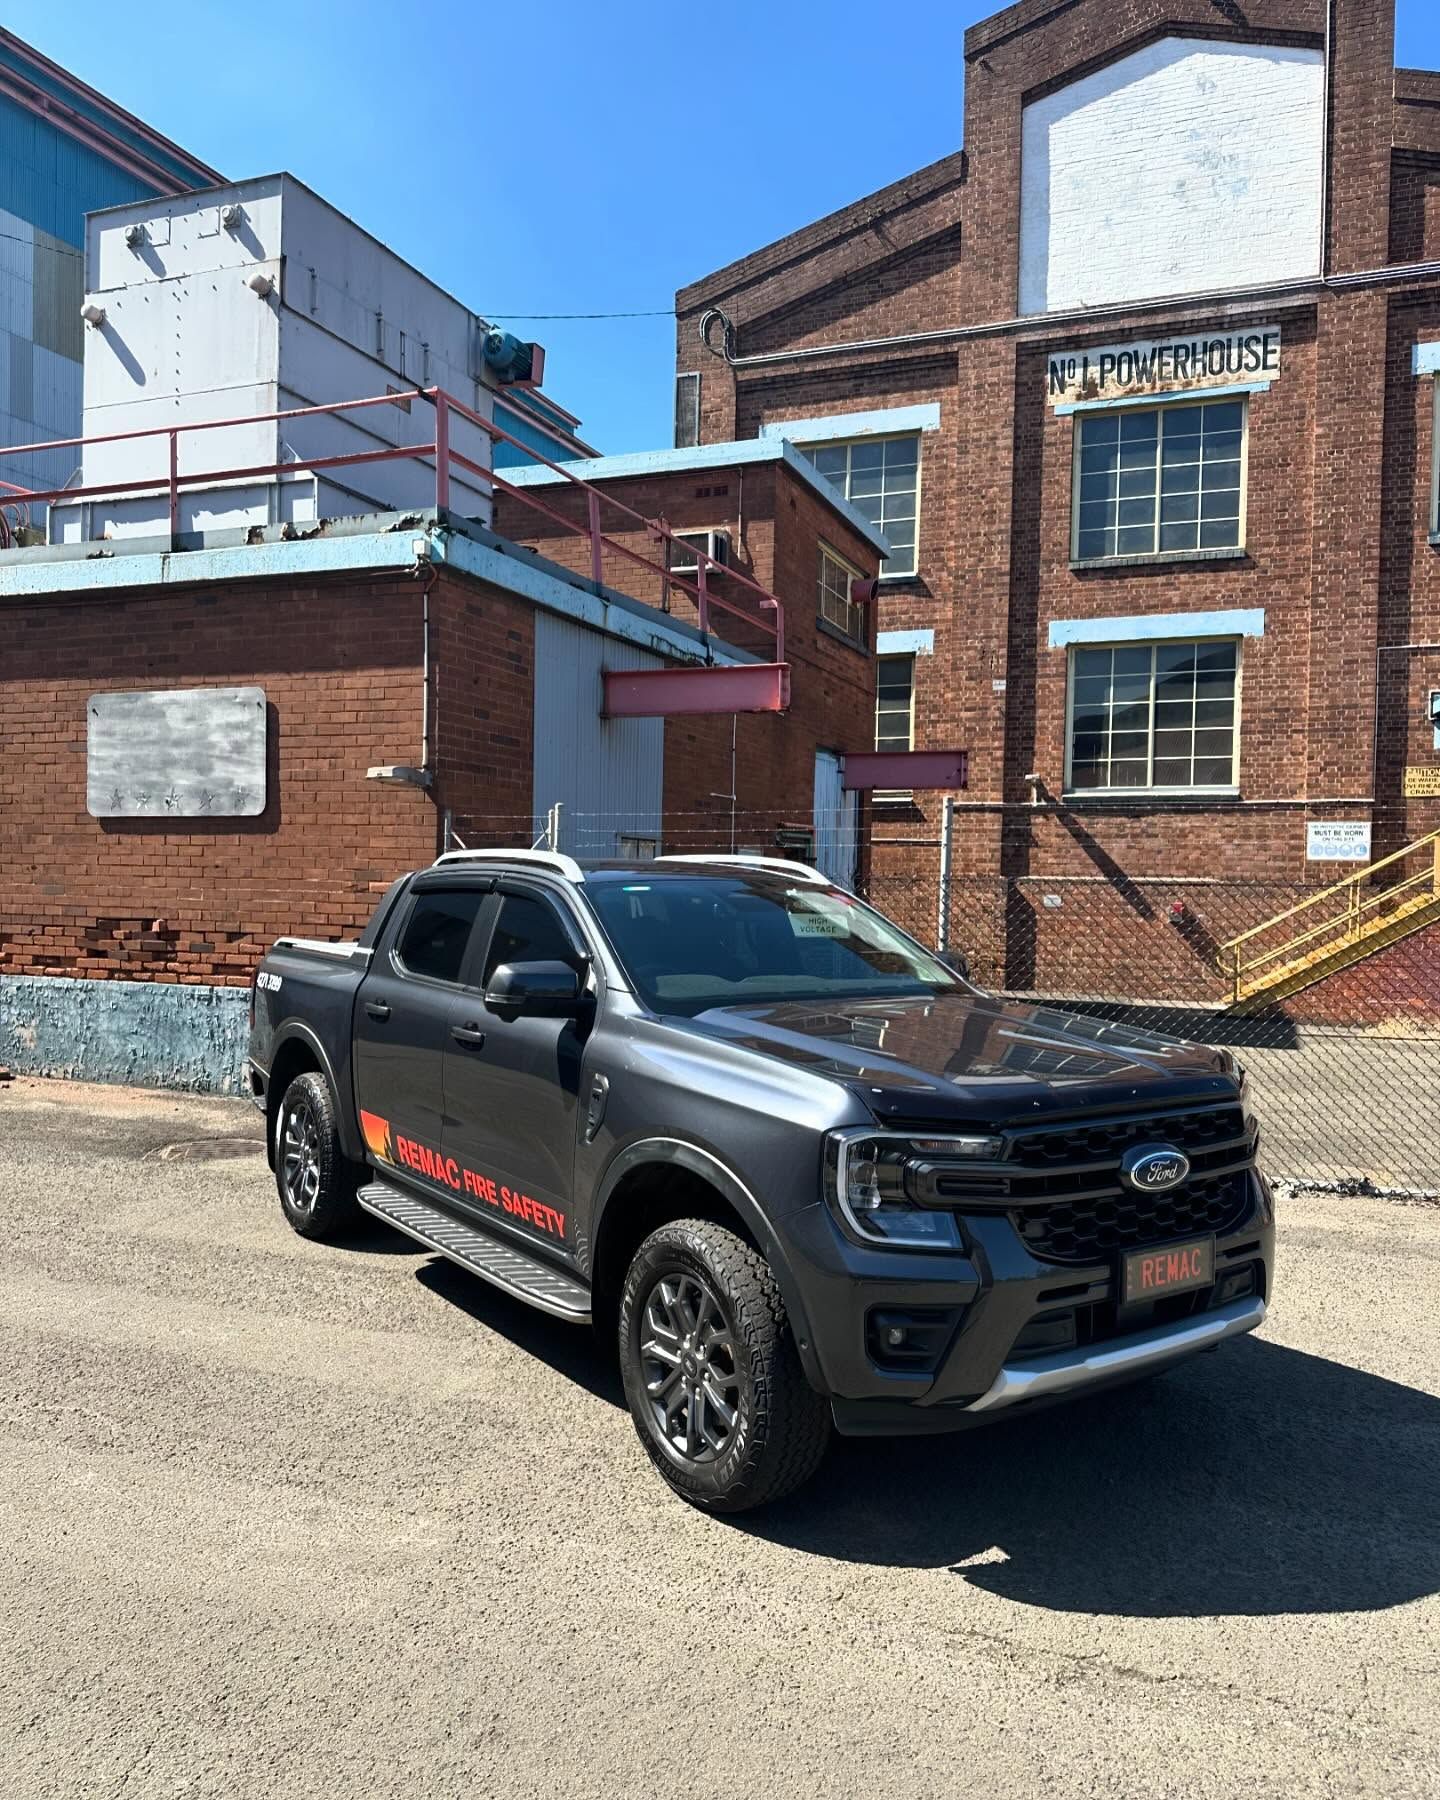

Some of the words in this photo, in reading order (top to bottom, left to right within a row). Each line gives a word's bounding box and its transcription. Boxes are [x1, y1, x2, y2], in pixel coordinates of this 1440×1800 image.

[1100, 332, 1279, 389] POWERHOUSE
[800, 926, 837, 934] VOLTAGE
[808, 917, 828, 925] HIGH
[396, 1135, 460, 1190] REMAC
[463, 1168, 498, 1206] FIRE
[500, 1186, 567, 1238] SAFETY
[1147, 1160, 1178, 1182] Ford
[1141, 1248, 1201, 1288] REMAC
